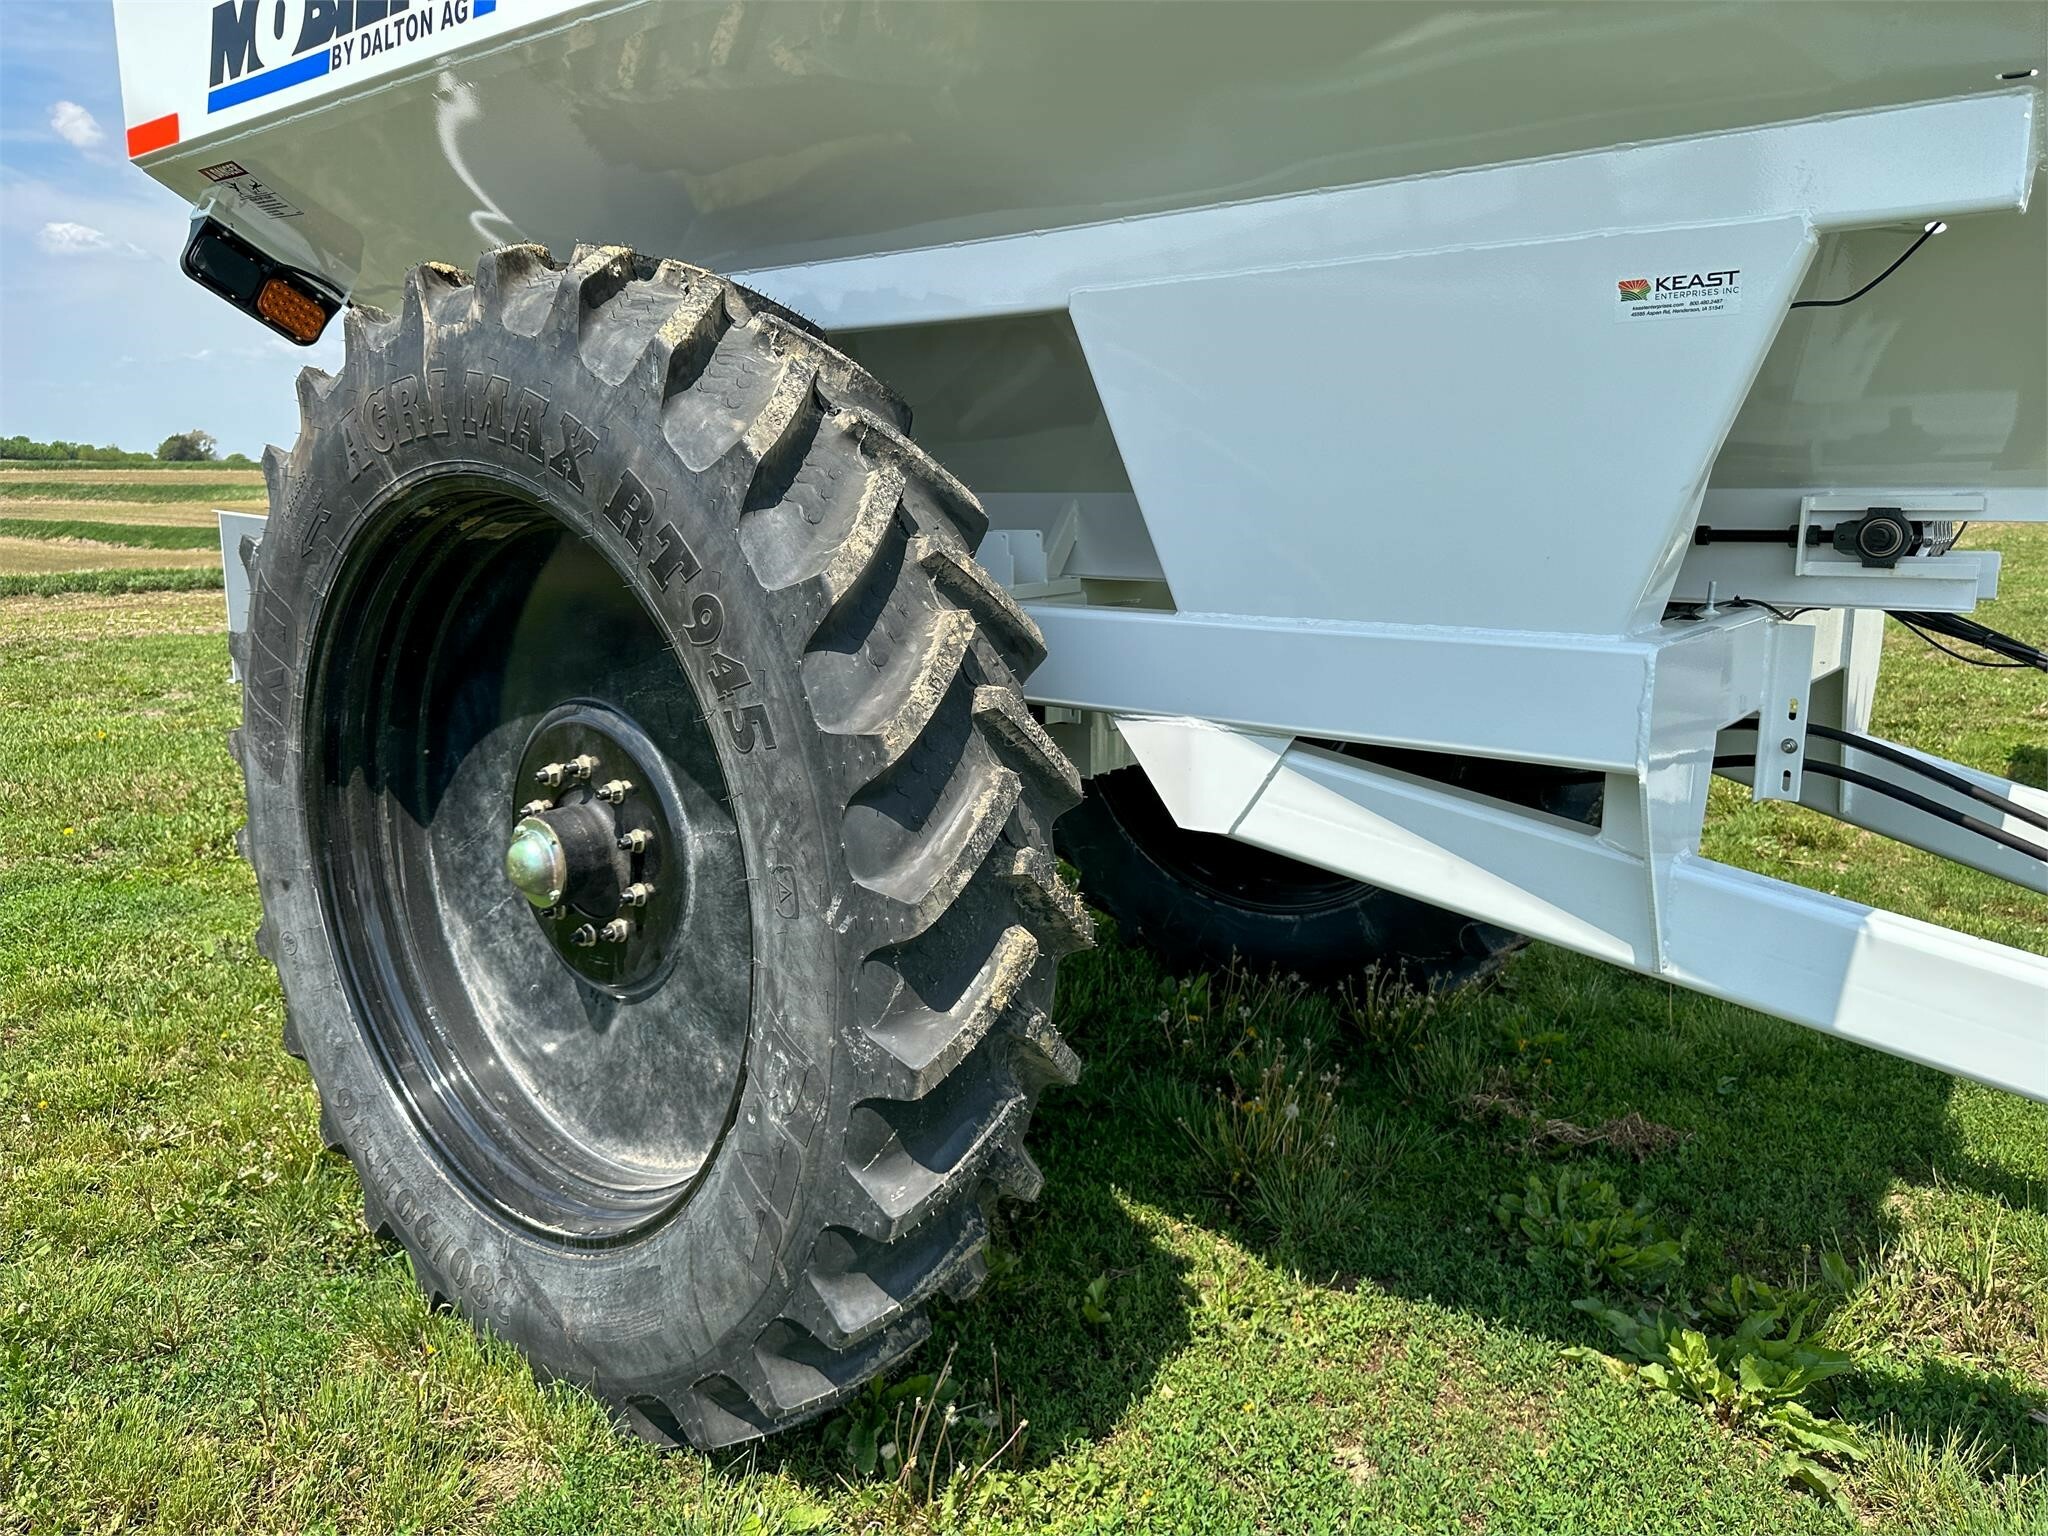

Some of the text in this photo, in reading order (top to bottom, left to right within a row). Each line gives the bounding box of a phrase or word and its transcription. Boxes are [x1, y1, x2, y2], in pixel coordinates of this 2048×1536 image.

[331, 0, 468, 71] BY DALTON AG
[1655, 270, 1740, 292] KEAST
[1655, 286, 1740, 300] ENTERPRISES INC
[602, 467, 702, 593] RT
[682, 592, 777, 753] 945
